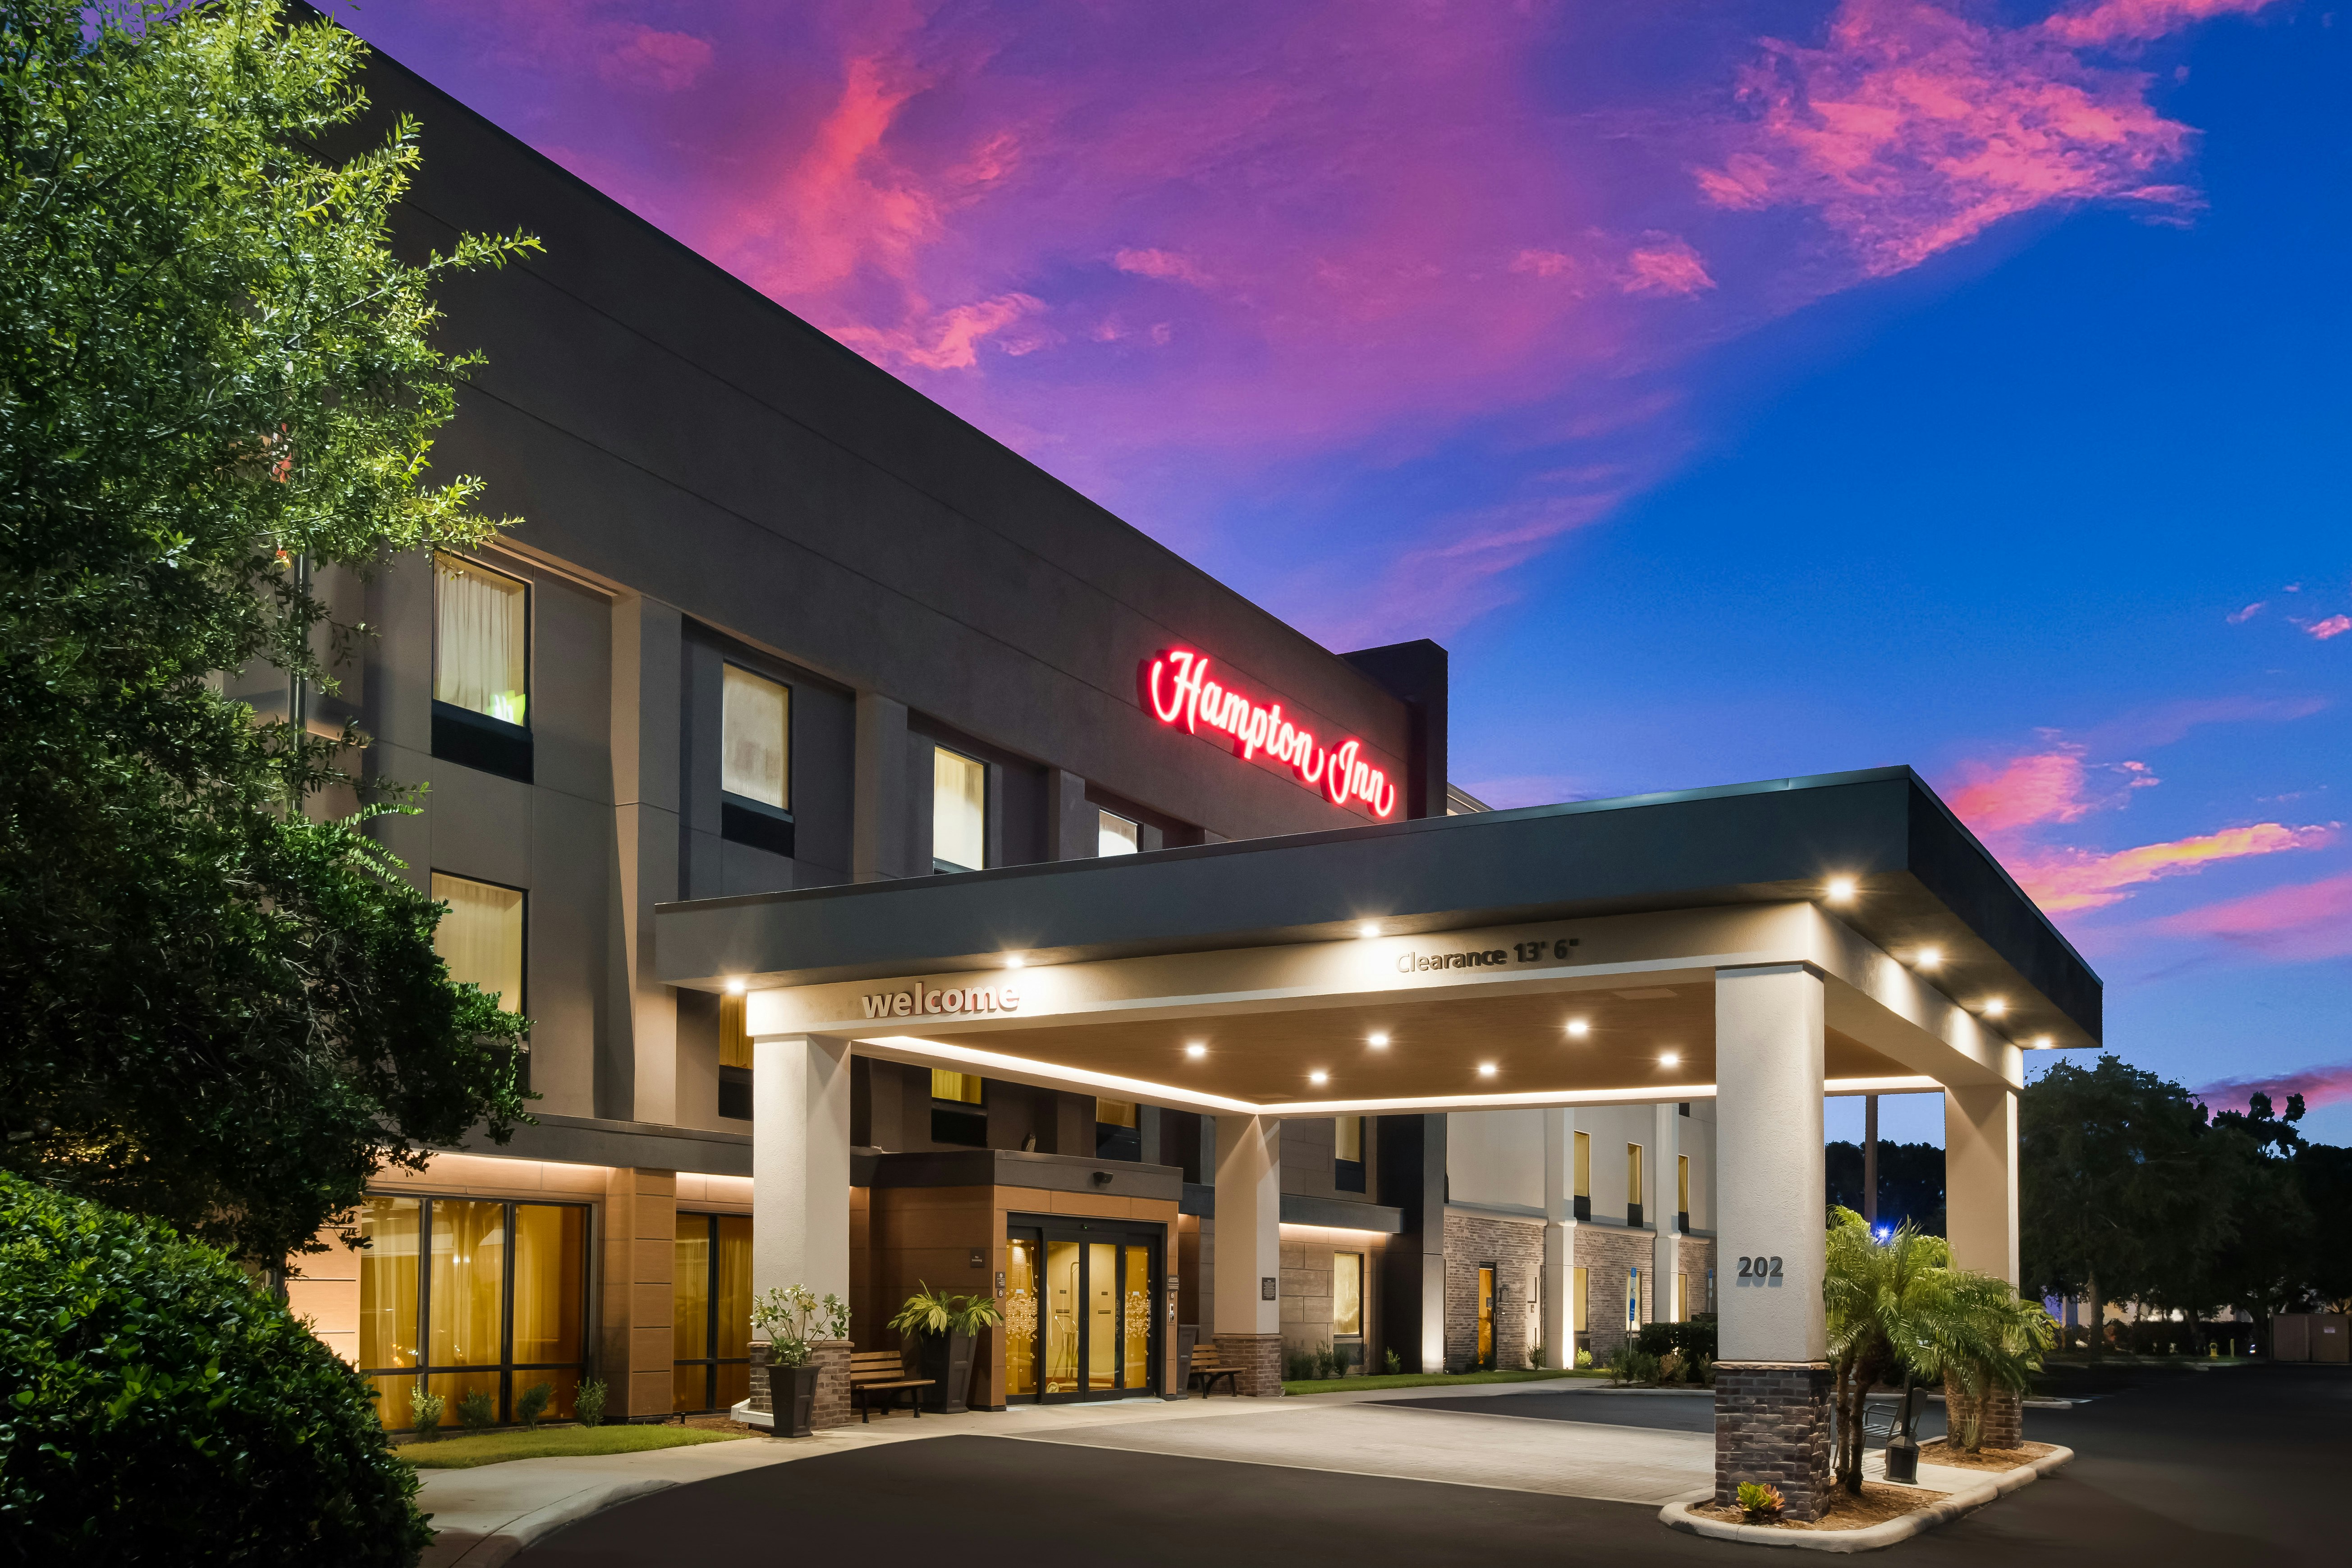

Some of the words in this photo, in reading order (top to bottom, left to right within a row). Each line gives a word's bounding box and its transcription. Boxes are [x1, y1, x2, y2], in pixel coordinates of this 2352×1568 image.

[1150, 651, 1325, 782] Hampton
[1328, 741, 1394, 817] Inn
[1396, 950, 1508, 973] Clearance
[1513, 941, 1545, 963] 13'
[1553, 939, 1580, 960] 6"
[862, 982, 1020, 1018] welcome
[1738, 1256, 1784, 1278] 202
